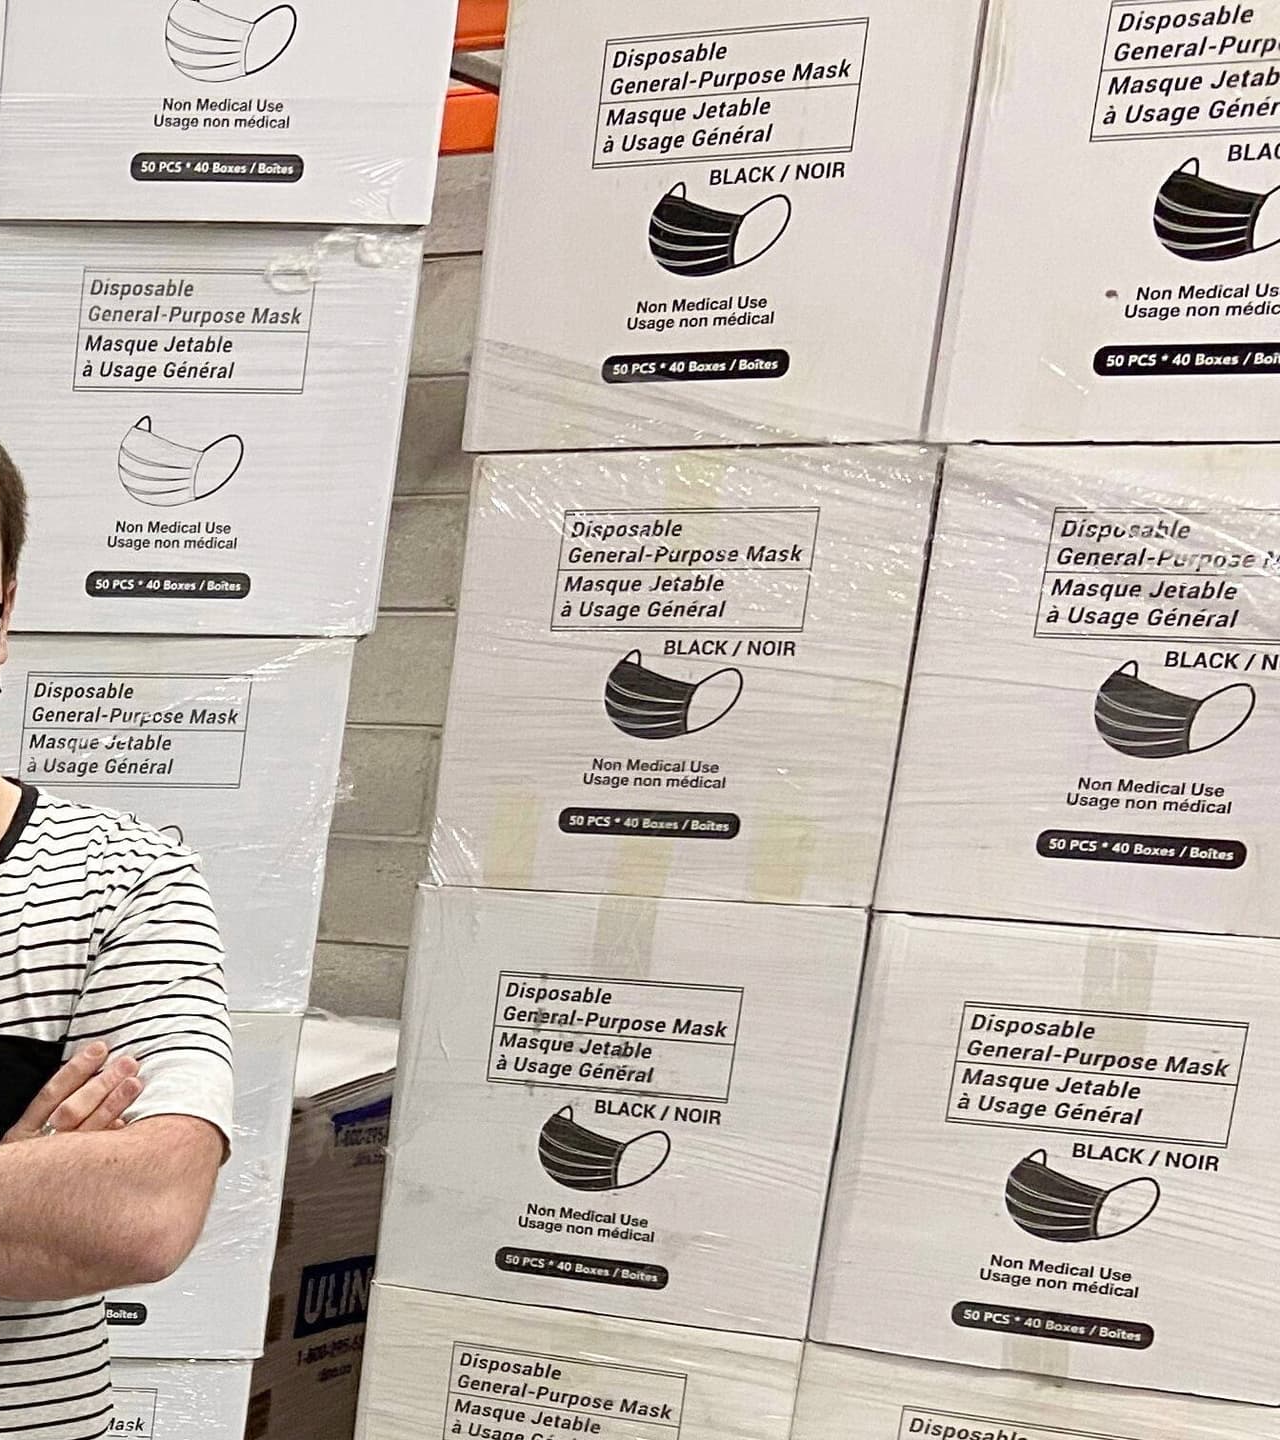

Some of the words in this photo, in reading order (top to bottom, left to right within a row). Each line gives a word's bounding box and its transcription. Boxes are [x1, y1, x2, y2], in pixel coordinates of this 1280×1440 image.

[612, 42, 727, 70] Disposable
[610, 70, 785, 95] General-Purpose
[792, 59, 851, 82] Mask
[606, 105, 686, 128] Masque
[693, 98, 771, 121] Jetable
[602, 136, 614, 153] à
[622, 130, 684, 153] Usage
[692, 124, 773, 147] Général
[709, 166, 774, 185] BLACK
[780, 164, 791, 181] /
[795, 162, 845, 180] NOIR
[1072, 1142, 1144, 1165] BLACK
[1148, 1150, 1162, 1166] /
[1165, 1151, 1220, 1172] NOIR
